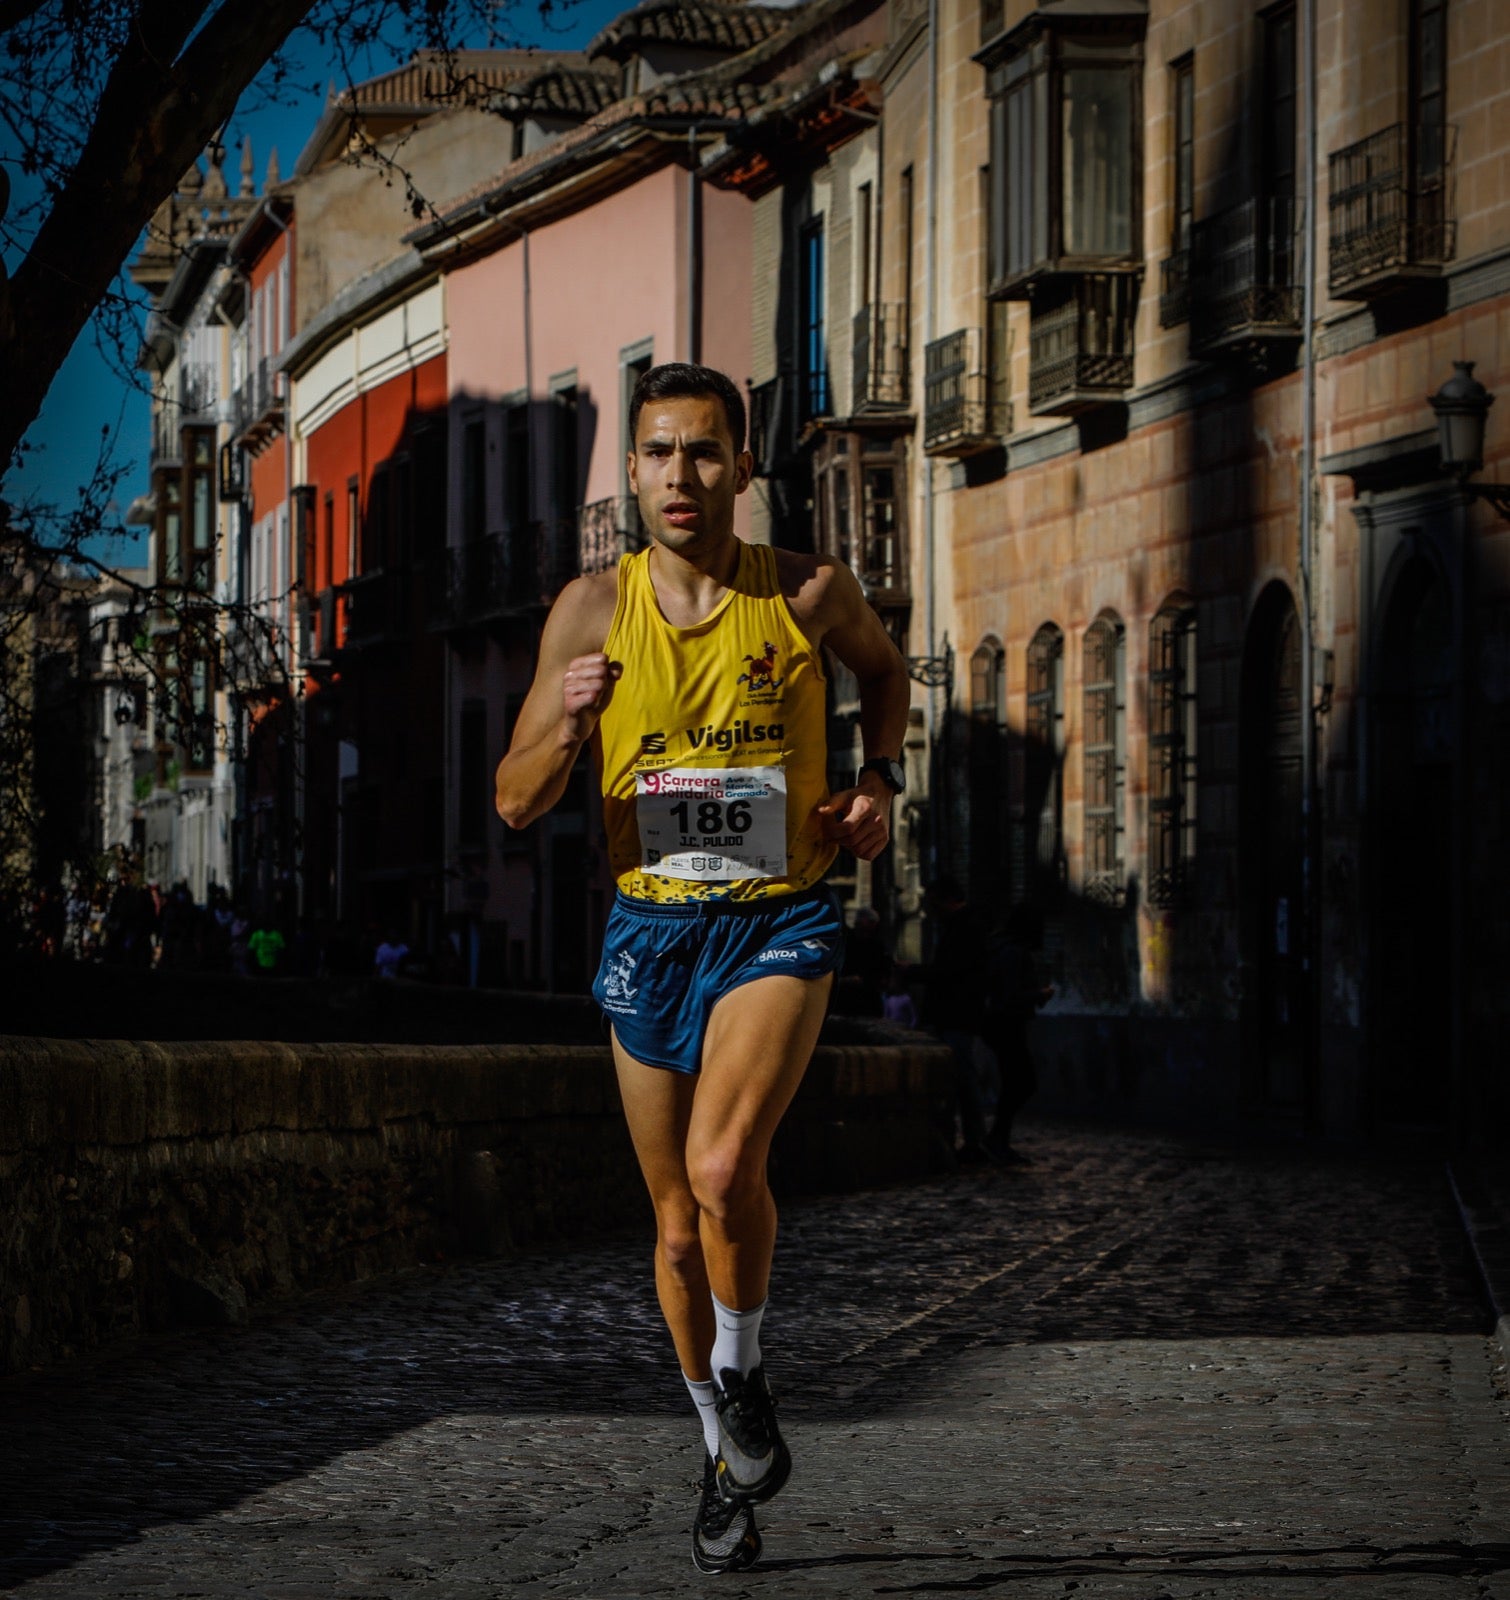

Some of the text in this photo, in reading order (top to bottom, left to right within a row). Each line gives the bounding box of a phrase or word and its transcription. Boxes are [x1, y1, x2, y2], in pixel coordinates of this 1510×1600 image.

[685, 720, 784, 751] Vigilsa
[644, 772, 661, 796] 9
[662, 773, 720, 786] Carrera
[661, 786, 724, 799] Solidaria
[670, 800, 752, 833] 186
[679, 835, 743, 848] J.C. PULIDO
